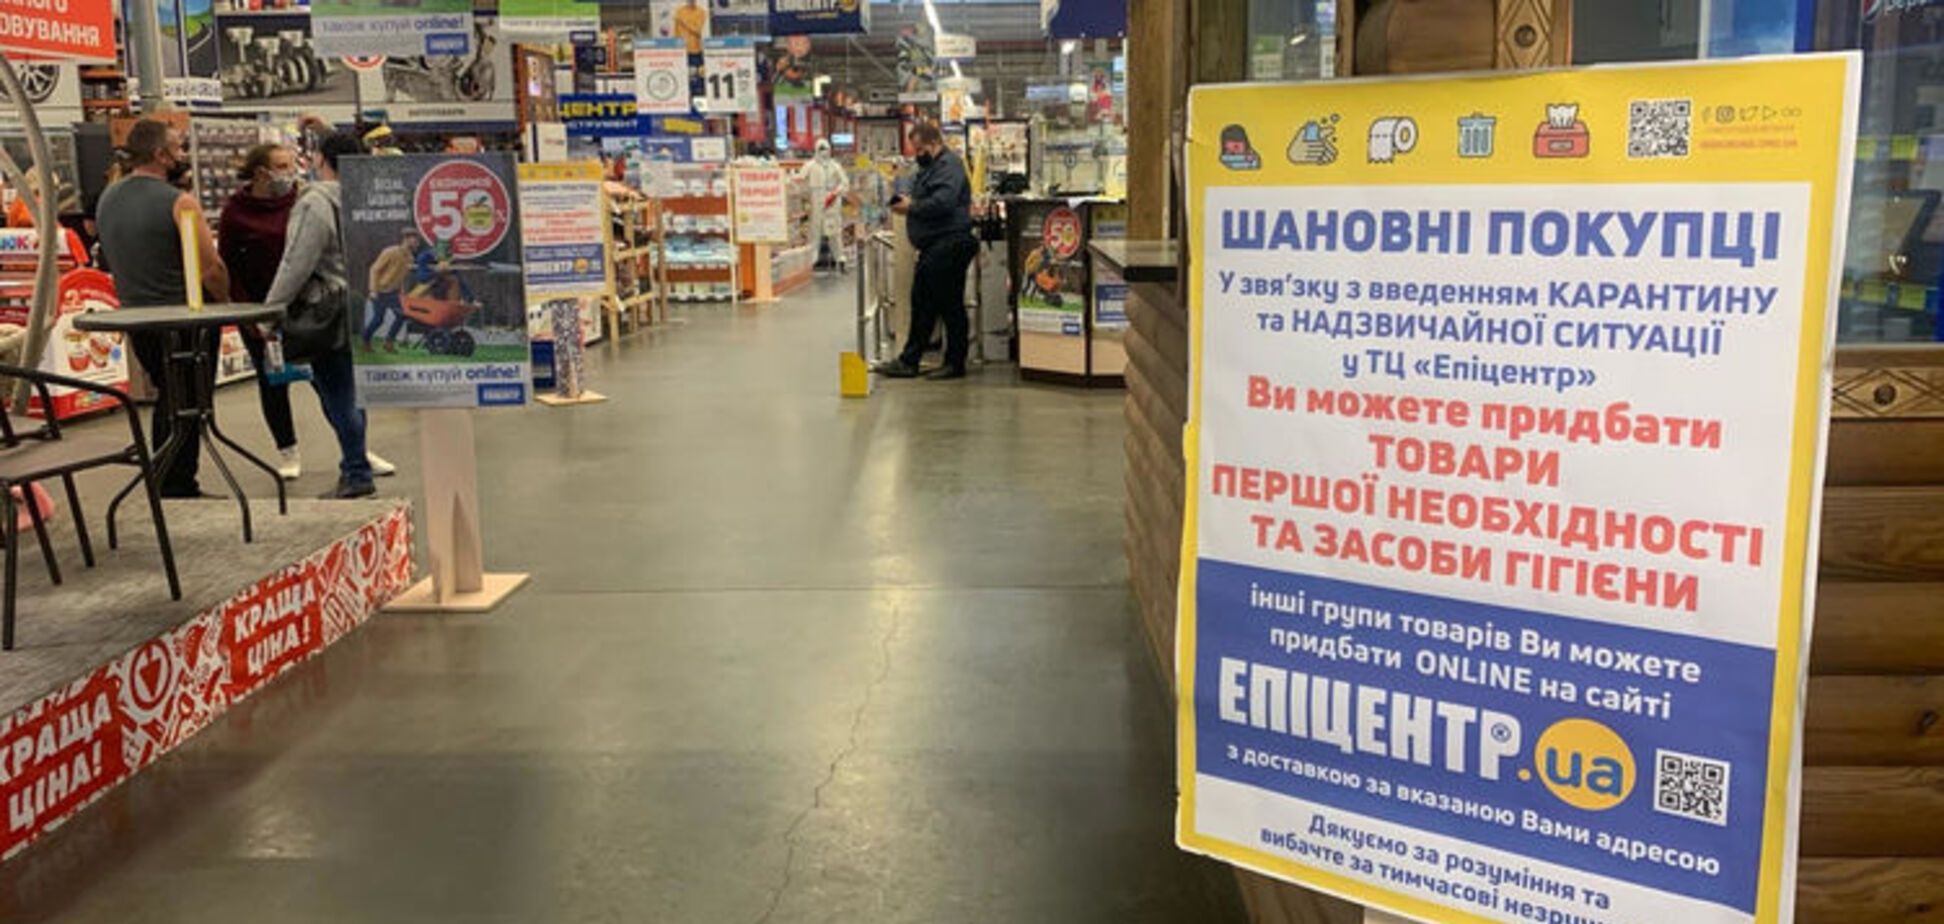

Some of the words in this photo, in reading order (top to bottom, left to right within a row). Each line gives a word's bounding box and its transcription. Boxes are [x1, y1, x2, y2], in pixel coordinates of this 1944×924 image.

[709, 73, 734, 99] 11
[1222, 210, 1470, 254] ШАНОВНІ
[1488, 210, 1780, 267] ПОКУПЦІ
[1219, 271, 1234, 293] У
[1346, 281, 1361, 300] з
[1369, 281, 1538, 306] введенням
[1548, 281, 1778, 314] КАРАНТИНУ
[1257, 312, 1284, 332] та
[1292, 310, 1547, 346] НАДЗВИЧАЙНОЇ
[1554, 320, 1725, 358] СИТУАЦІЇ
[466, 364, 519, 380] online!
[1343, 354, 1358, 378] у
[1366, 350, 1405, 379] ТЦ
[1415, 354, 1596, 392] «Епіцентр»
[1247, 375, 1296, 411] Ви
[1306, 388, 1470, 428] можете
[1481, 401, 1721, 449] придбати
[1368, 434, 1559, 487] ТОВАРИ
[1212, 463, 1379, 516] ПЕРШОЇ
[1388, 484, 1763, 566] НЕОБХІДНОСТІ
[1251, 514, 1303, 552] ТА
[1313, 523, 1492, 582] ЗАСОБИ
[1505, 551, 1698, 612] ГІГІЄНИ
[235, 578, 316, 643] КРАЩА
[1251, 582, 1305, 615] інші
[1311, 599, 1392, 630] групи
[1400, 614, 1511, 651] товарів
[1520, 629, 1561, 660] Ви
[1569, 643, 1701, 683] можете
[247, 615, 310, 676] ЦІНА!
[1270, 627, 1402, 669] придбати
[1416, 649, 1532, 694] ONLINE
[1540, 677, 1577, 703] на
[1585, 685, 1672, 720] сайті
[9, 739, 102, 832] ЦІНА!
[1227, 744, 1238, 760] з
[1243, 749, 1361, 789] доставкою
[1366, 777, 1391, 797] за
[1397, 785, 1515, 826] вказаною
[1522, 809, 1590, 844] Вами
[1596, 832, 1720, 875] адресою
[1261, 828, 1344, 866] вибачте
[1350, 854, 1373, 874] за
[1380, 863, 1498, 910] тимчасові
[1308, 814, 1407, 857] Дякуємо
[1413, 845, 1439, 865] за
[1446, 853, 1576, 901] розуміння
[1582, 887, 1610, 910] та
